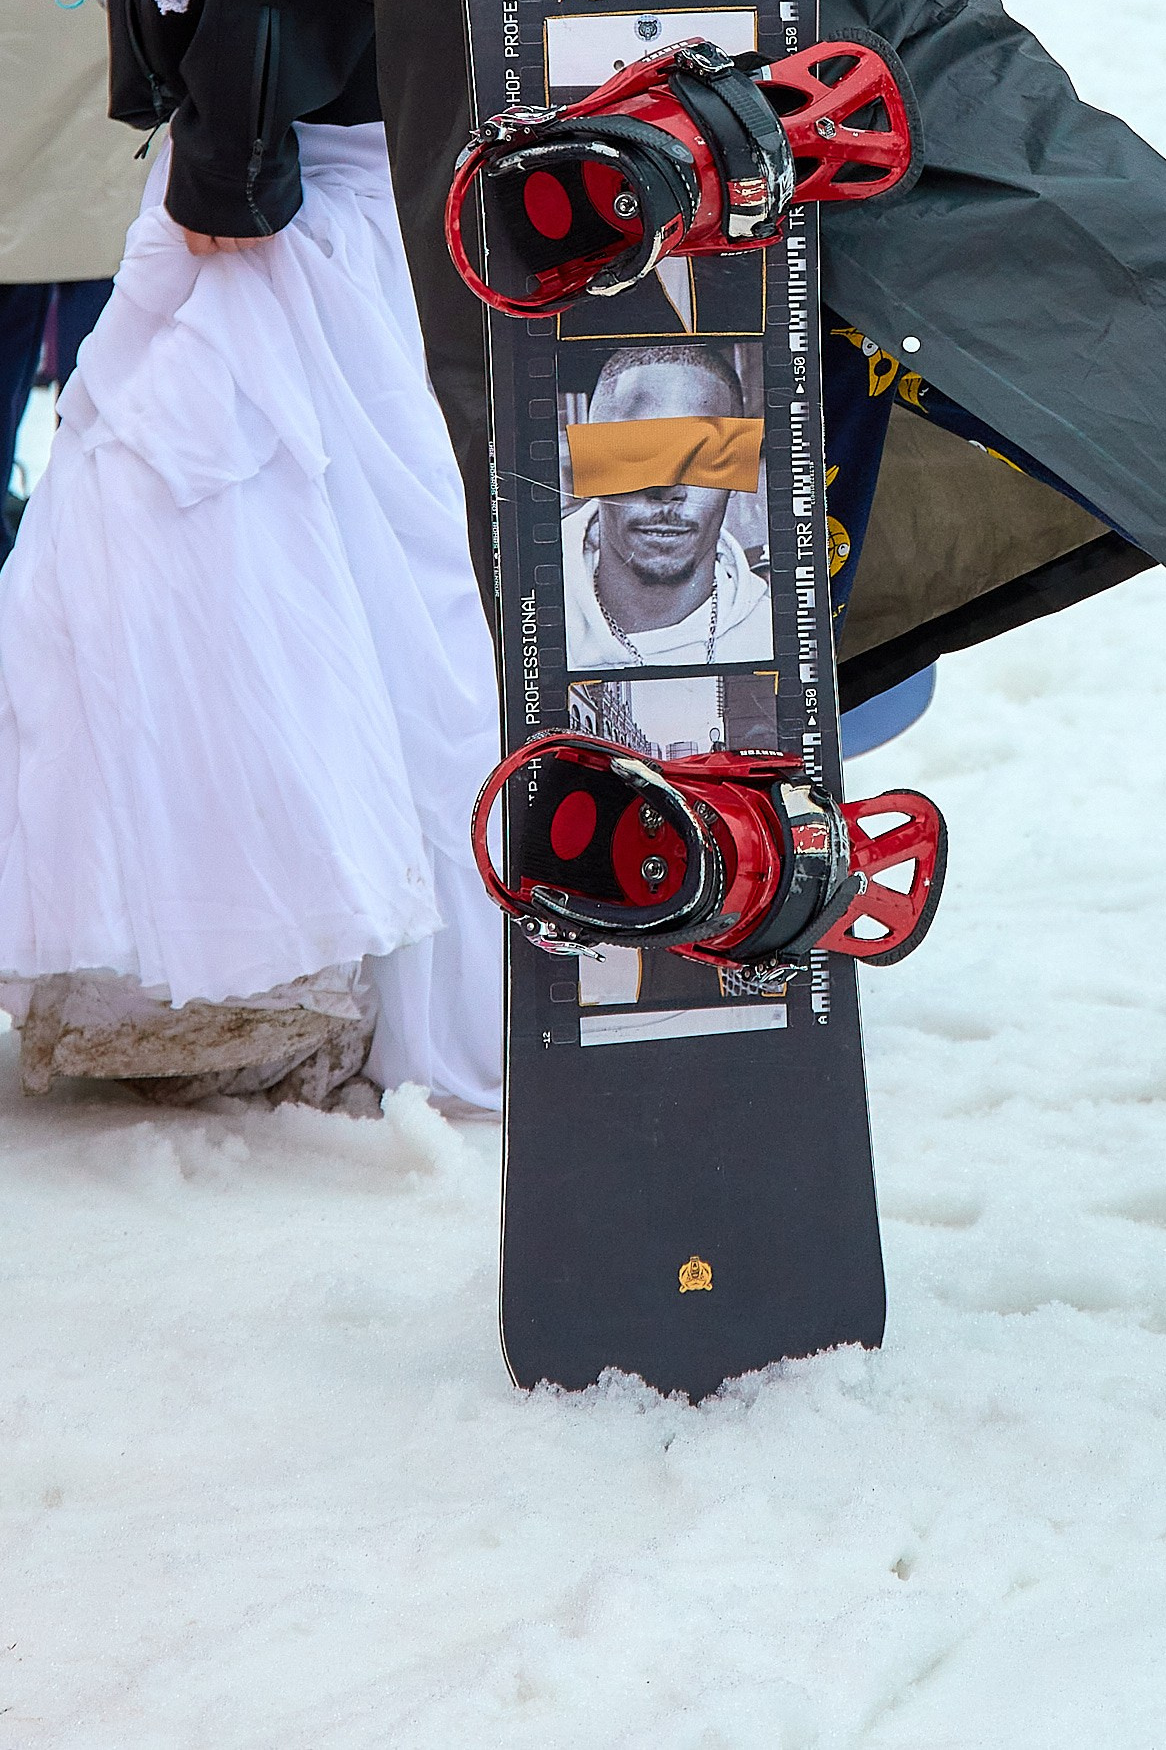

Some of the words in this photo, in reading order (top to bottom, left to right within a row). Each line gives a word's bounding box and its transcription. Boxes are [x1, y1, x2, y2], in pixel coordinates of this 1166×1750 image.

[793, 357, 807, 382] 150
[796, 522, 815, 560] TRR
[520, 589, 541, 725] PROFESSIONAL
[805, 689, 818, 714] 150
